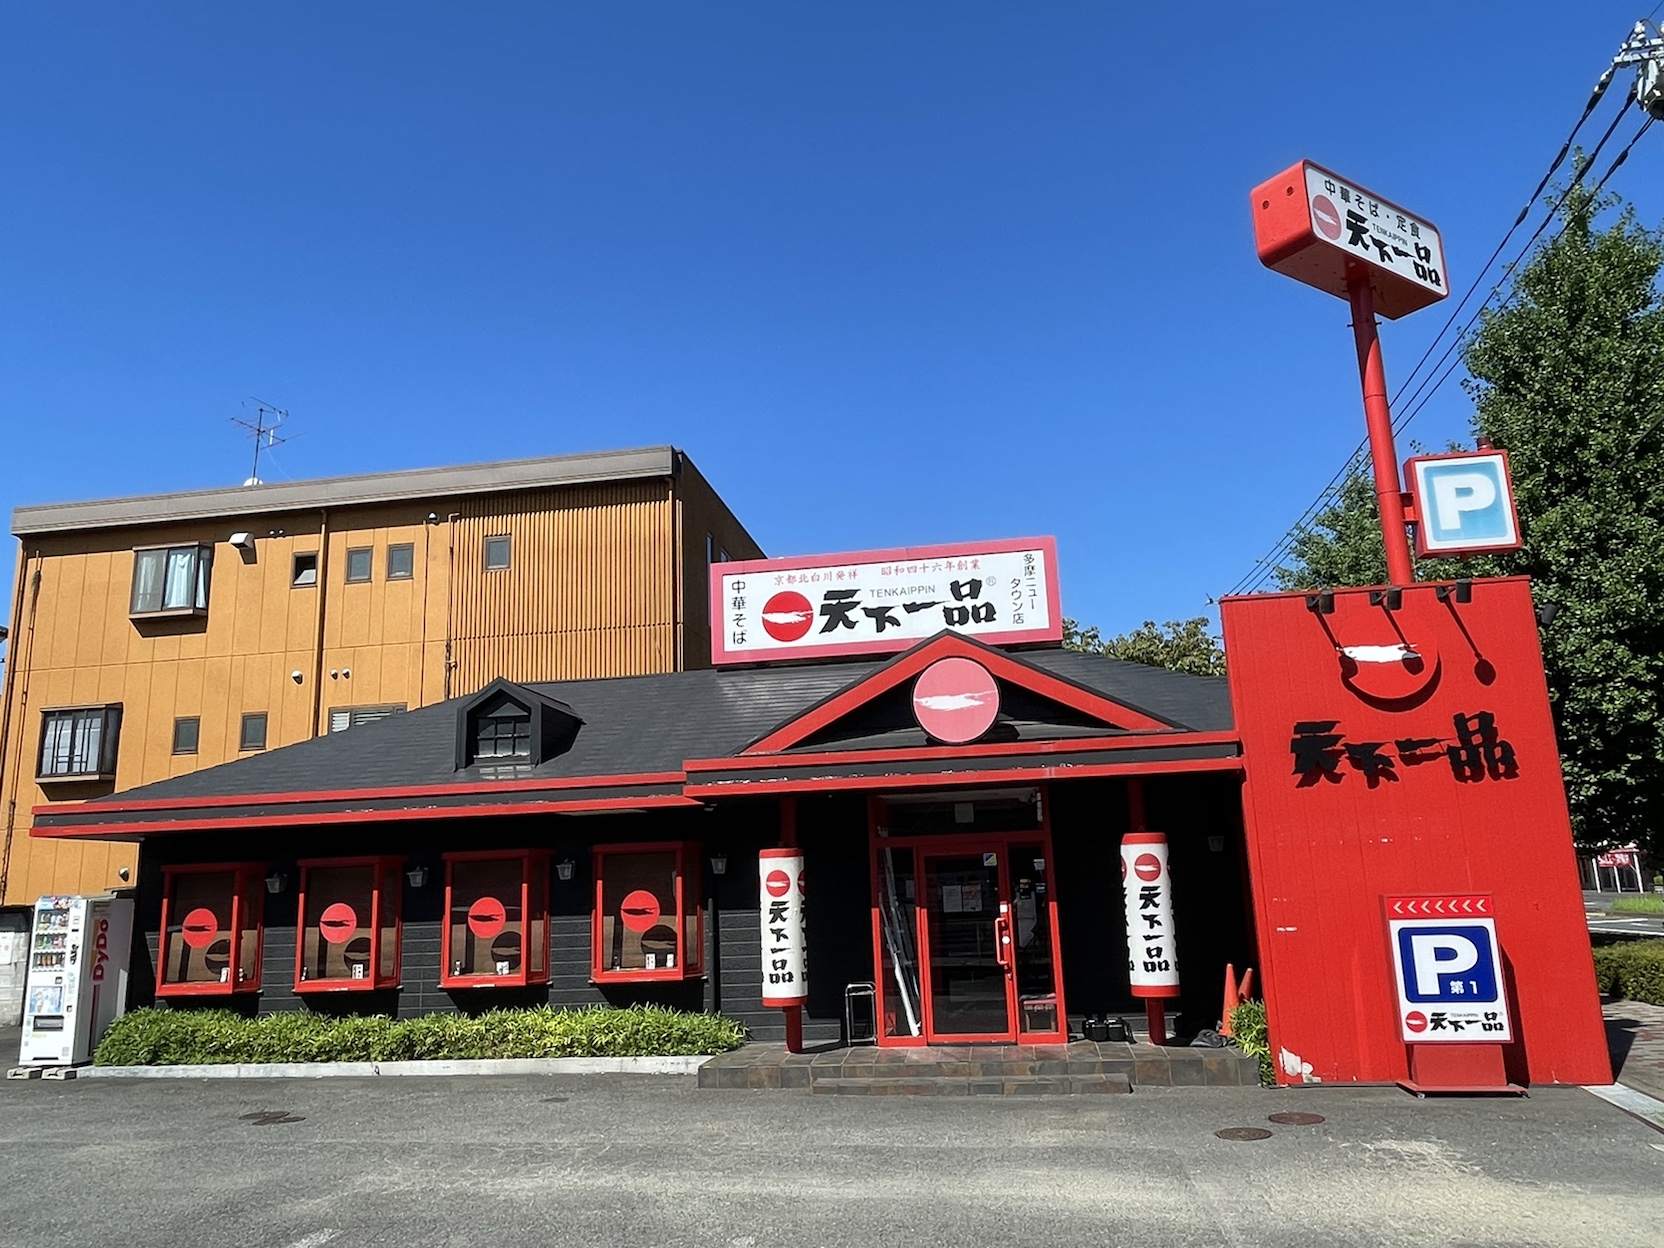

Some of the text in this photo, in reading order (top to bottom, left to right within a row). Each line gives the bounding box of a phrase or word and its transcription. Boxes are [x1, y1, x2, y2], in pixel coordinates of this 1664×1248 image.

[1324, 179, 1422, 240] 中華そば・定食
[1345, 208, 1442, 287] 天下一品
[1432, 473, 1497, 531] P
[773, 568, 859, 586] 京都北白川発祥
[868, 584, 937, 599] TENKAIPPIN
[880, 558, 981, 576] 昭和四十六年創業
[731, 579, 748, 645] 中華そば
[819, 577, 997, 634] 天下一品
[1290, 710, 1518, 784] 天下一品
[92, 918, 110, 982] DyDo
[768, 900, 794, 985] 天下一品
[1138, 885, 1171, 974] 天下一品
[1411, 934, 1479, 996] P
[1429, 1011, 1505, 1033] 天下一品
